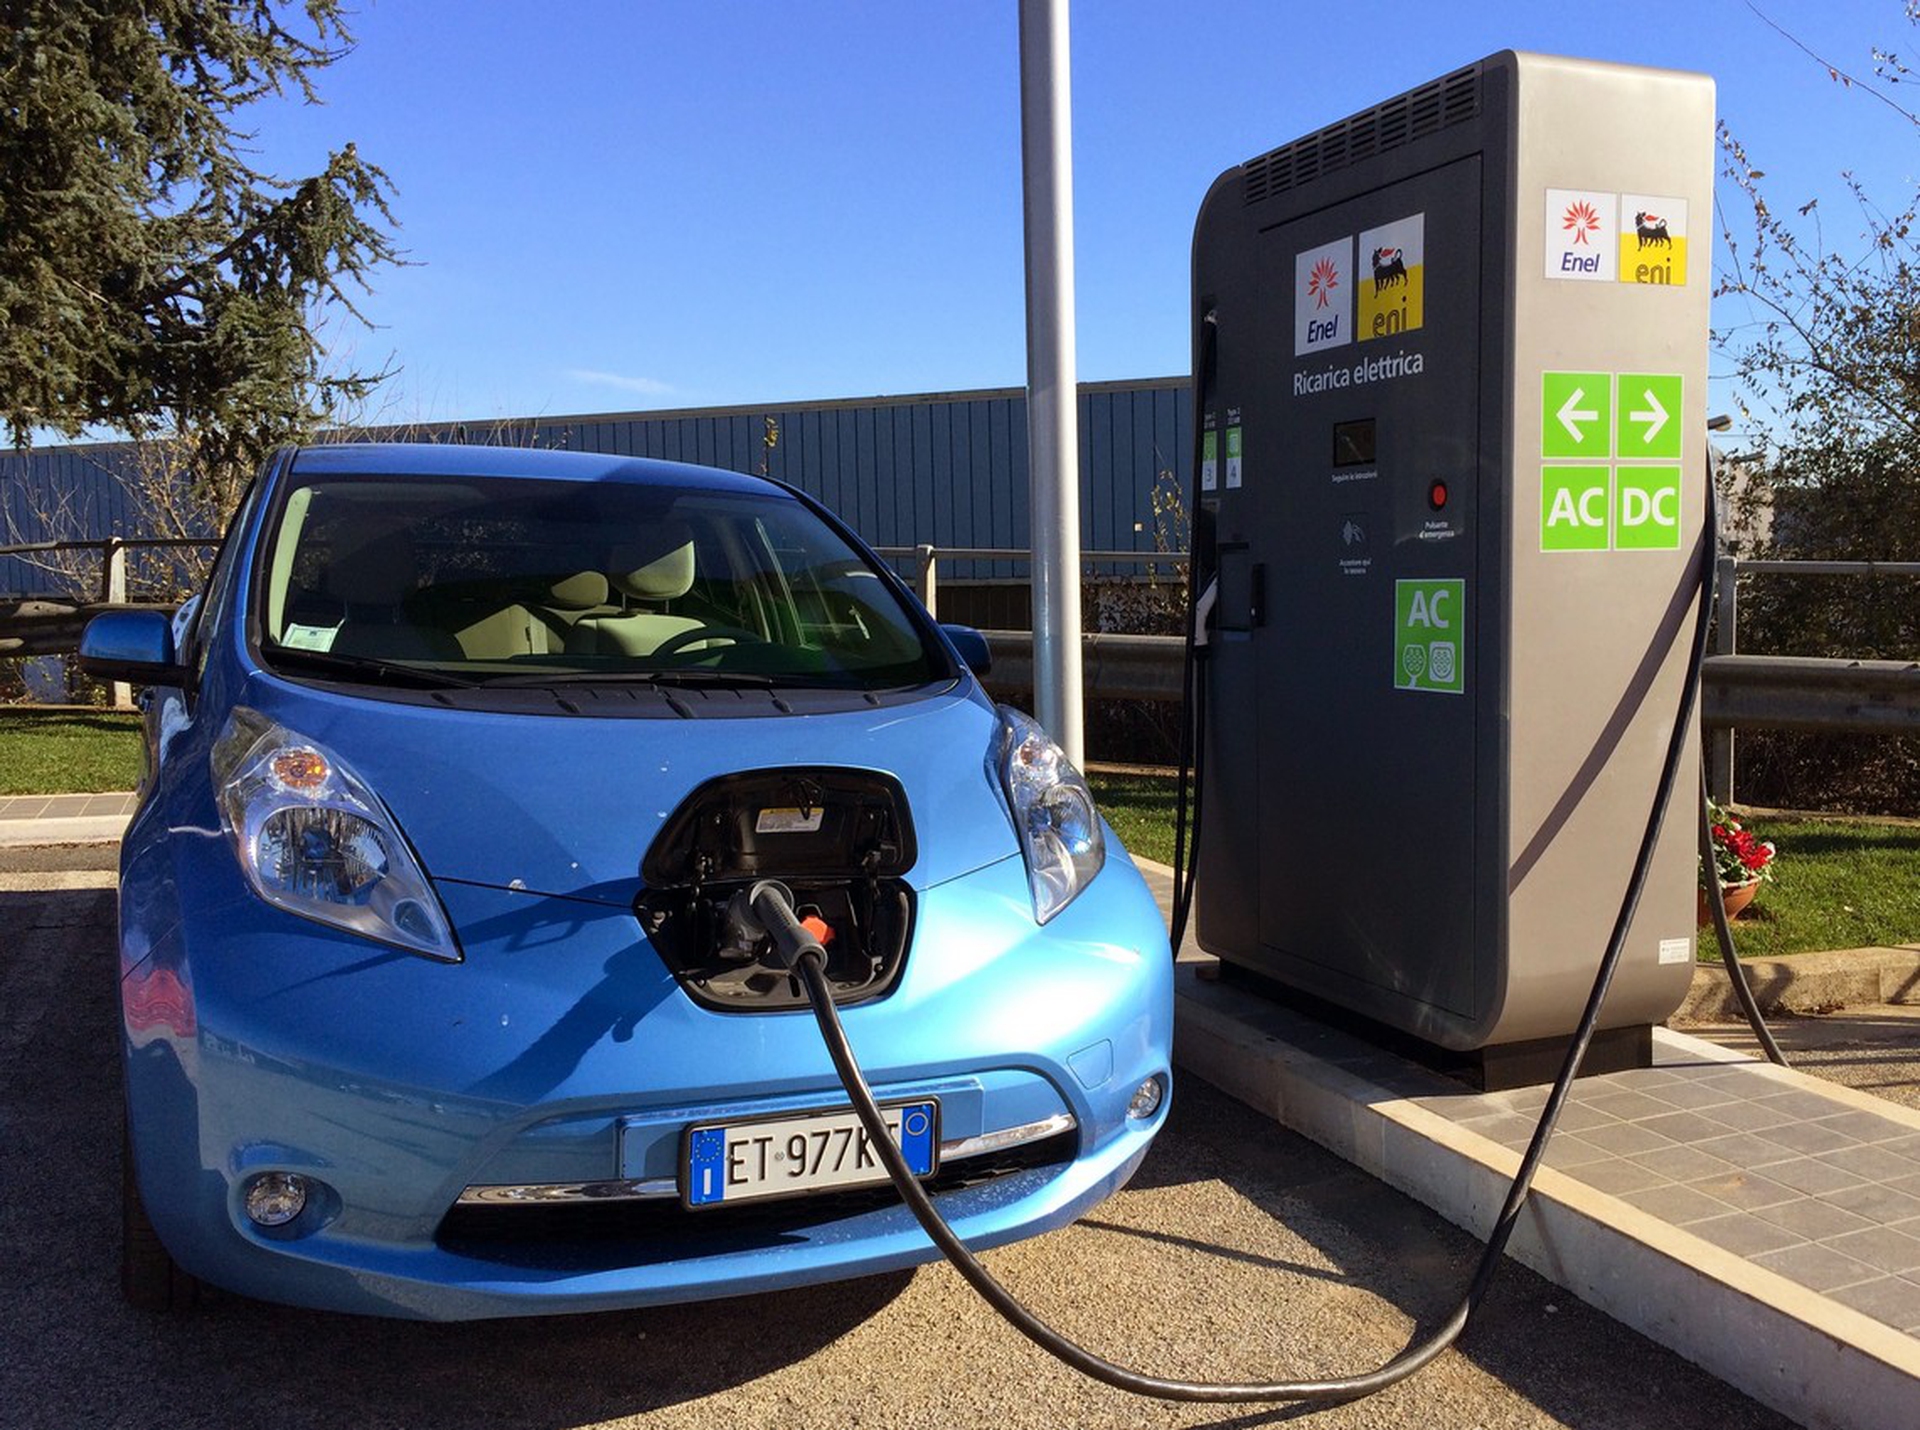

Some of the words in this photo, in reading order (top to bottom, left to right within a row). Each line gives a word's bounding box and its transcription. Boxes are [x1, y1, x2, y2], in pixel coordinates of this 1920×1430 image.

[1561, 251, 1601, 273] Enel
[1635, 257, 1671, 285] eni
[1307, 314, 1339, 344] Enel
[1372, 295, 1408, 338] eni
[1293, 364, 1350, 396] Ricarica
[1353, 350, 1424, 384] elettrica
[1546, 486, 1604, 527] AC
[1622, 486, 1676, 526] DC
[1407, 589, 1450, 629] AC
[727, 1137, 774, 1186] ET
